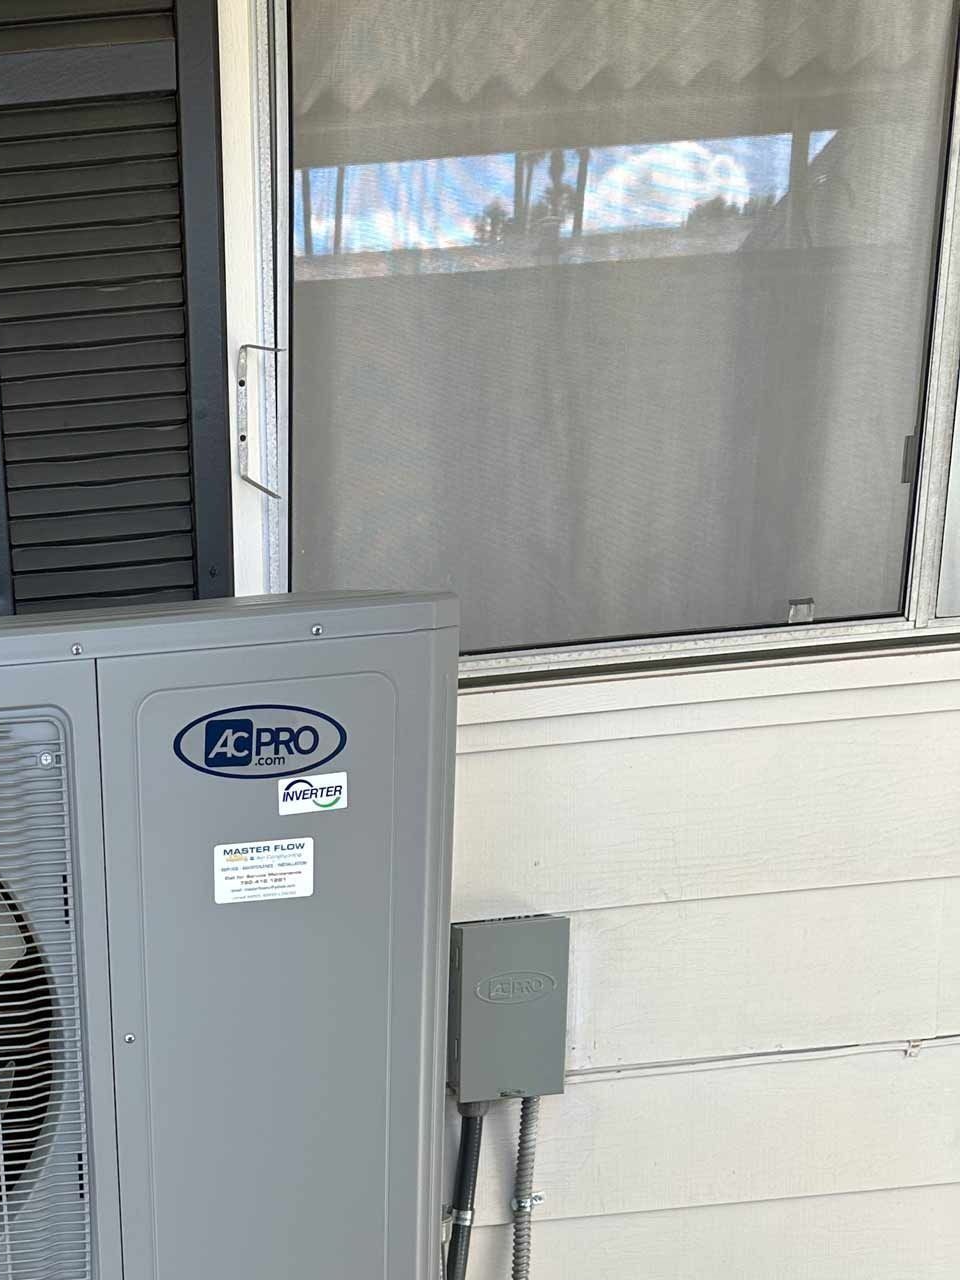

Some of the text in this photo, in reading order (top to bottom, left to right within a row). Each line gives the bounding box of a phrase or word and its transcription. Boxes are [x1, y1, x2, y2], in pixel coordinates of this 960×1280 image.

[254, 755, 286, 766] .com
[282, 785, 343, 802] INVERTER
[223, 842, 305, 856] MASTER FLOW
